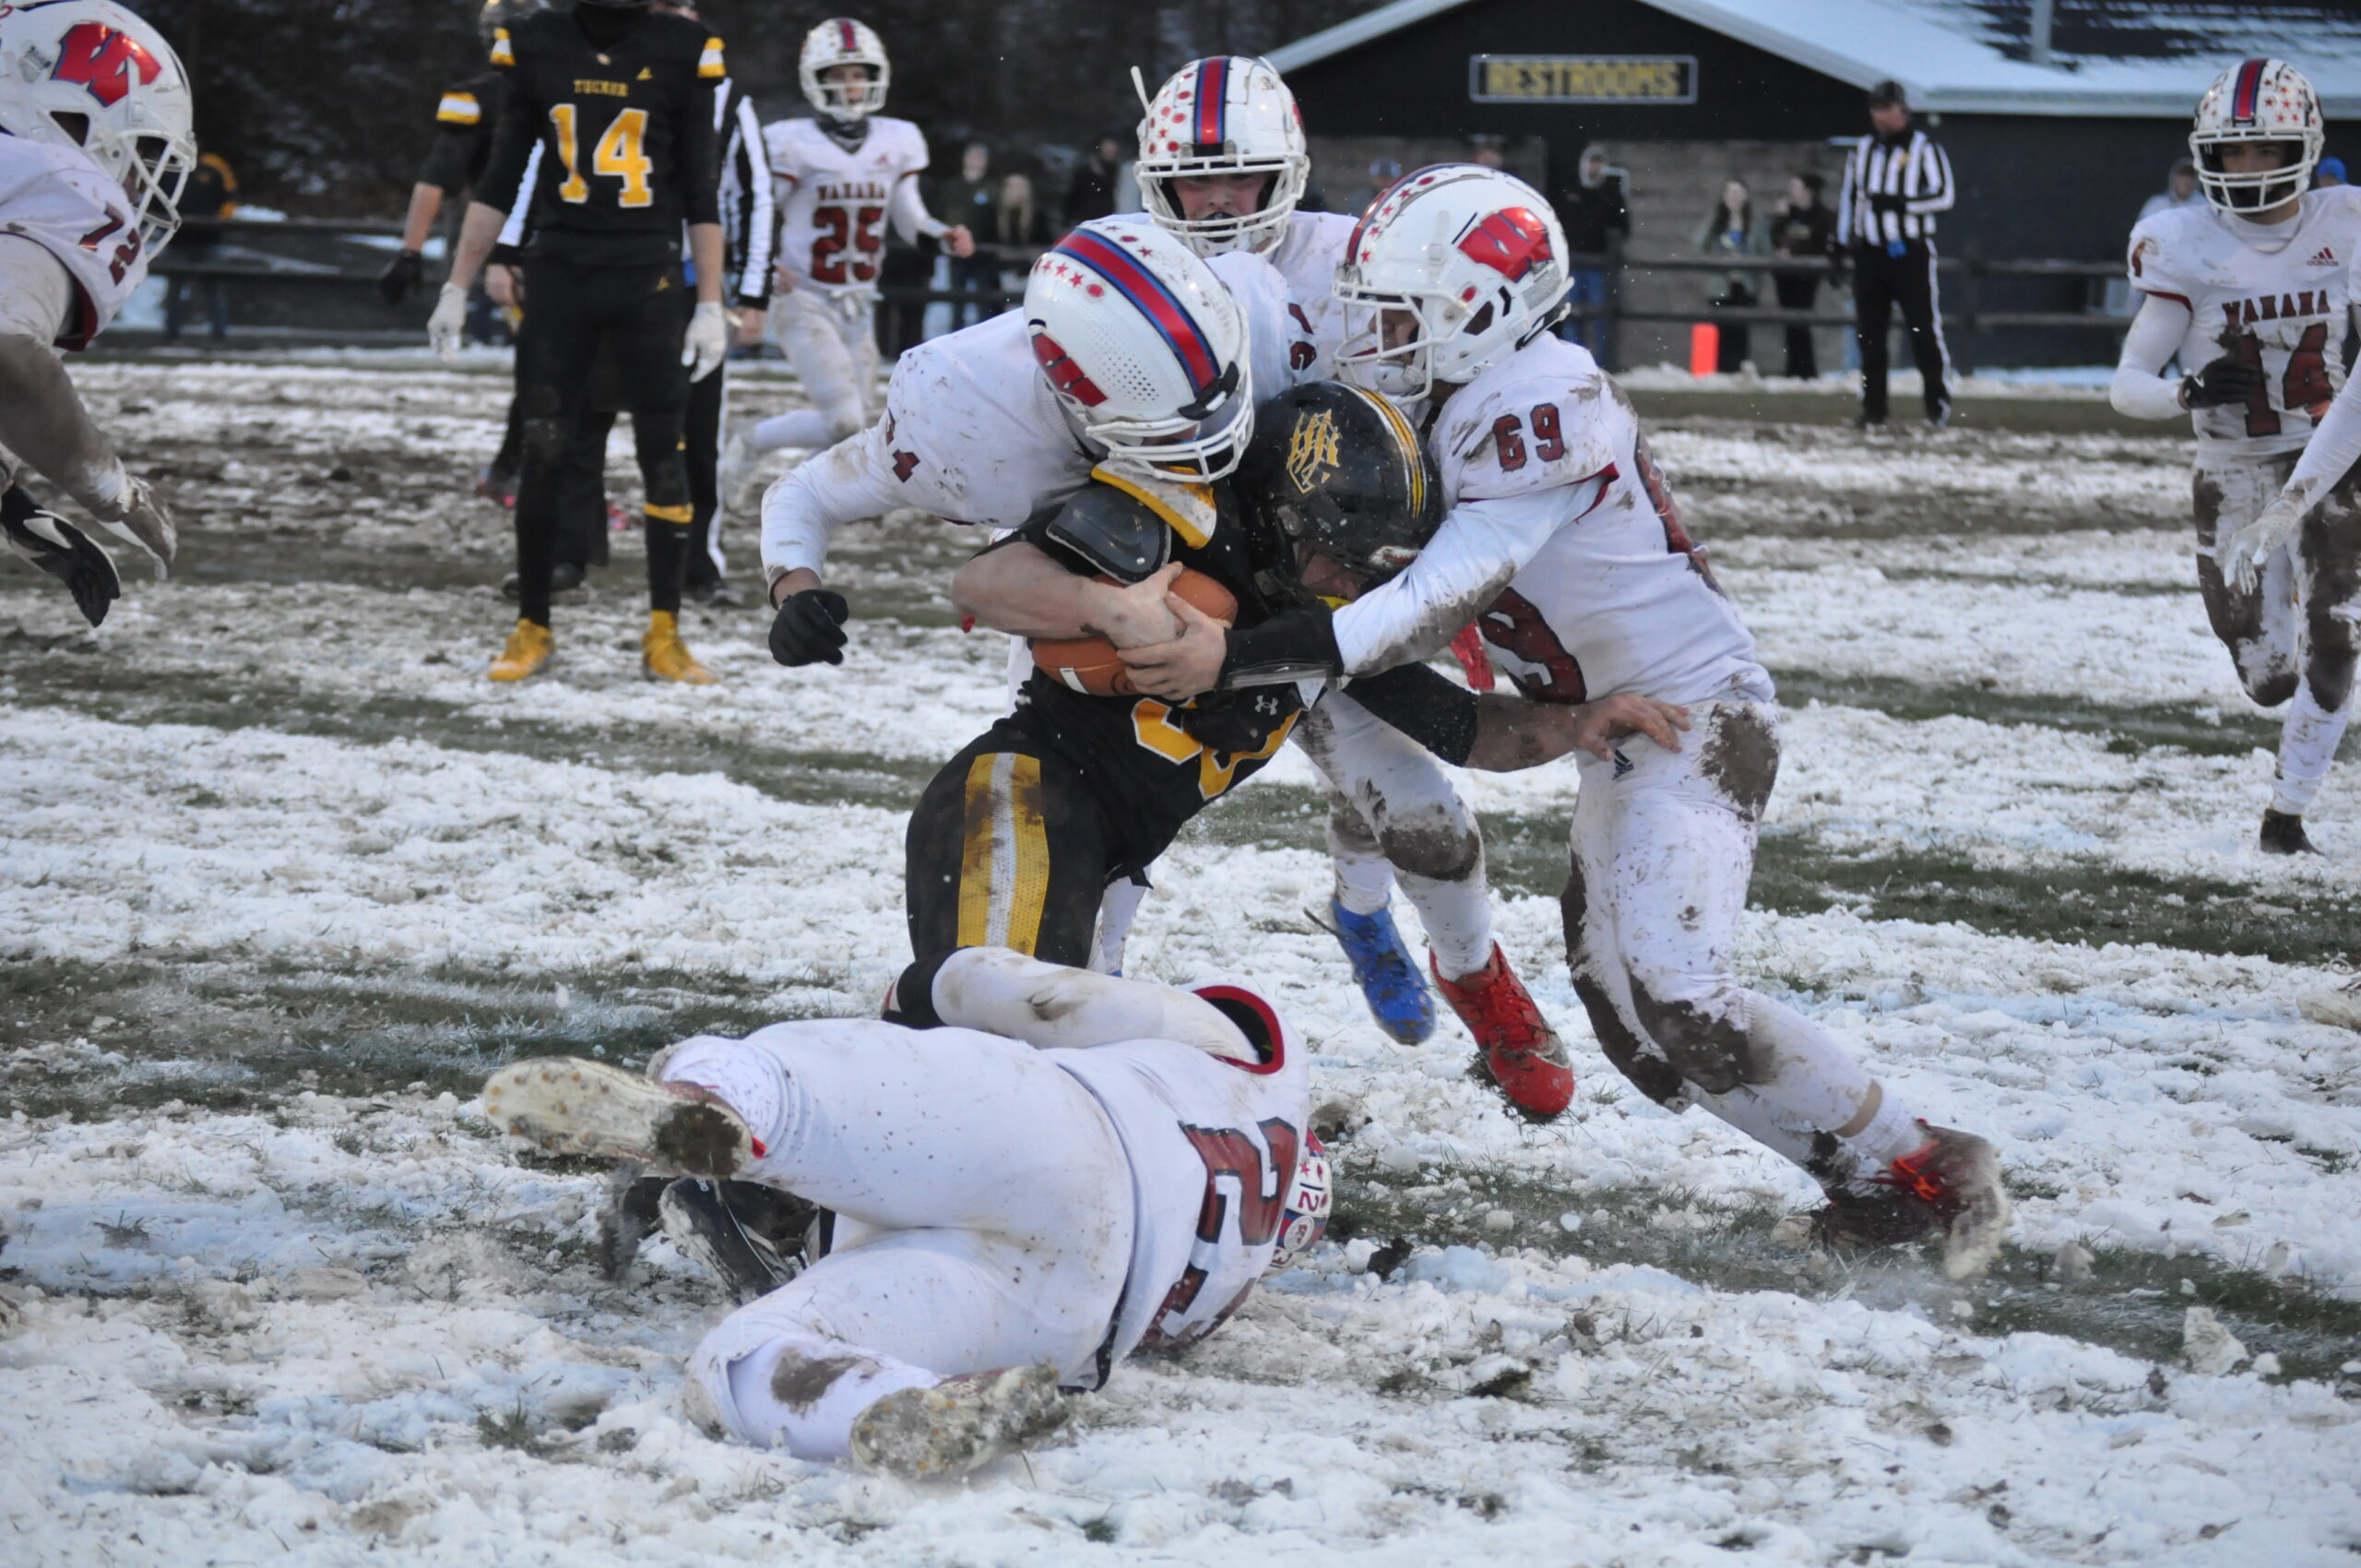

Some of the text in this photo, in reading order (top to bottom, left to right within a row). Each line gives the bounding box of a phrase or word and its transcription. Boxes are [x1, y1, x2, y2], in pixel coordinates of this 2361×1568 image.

[1487, 61, 1680, 97] RESTROOMS
[549, 103, 654, 208] 14
[811, 205, 884, 285] 25
[1491, 402, 1566, 472] 69
